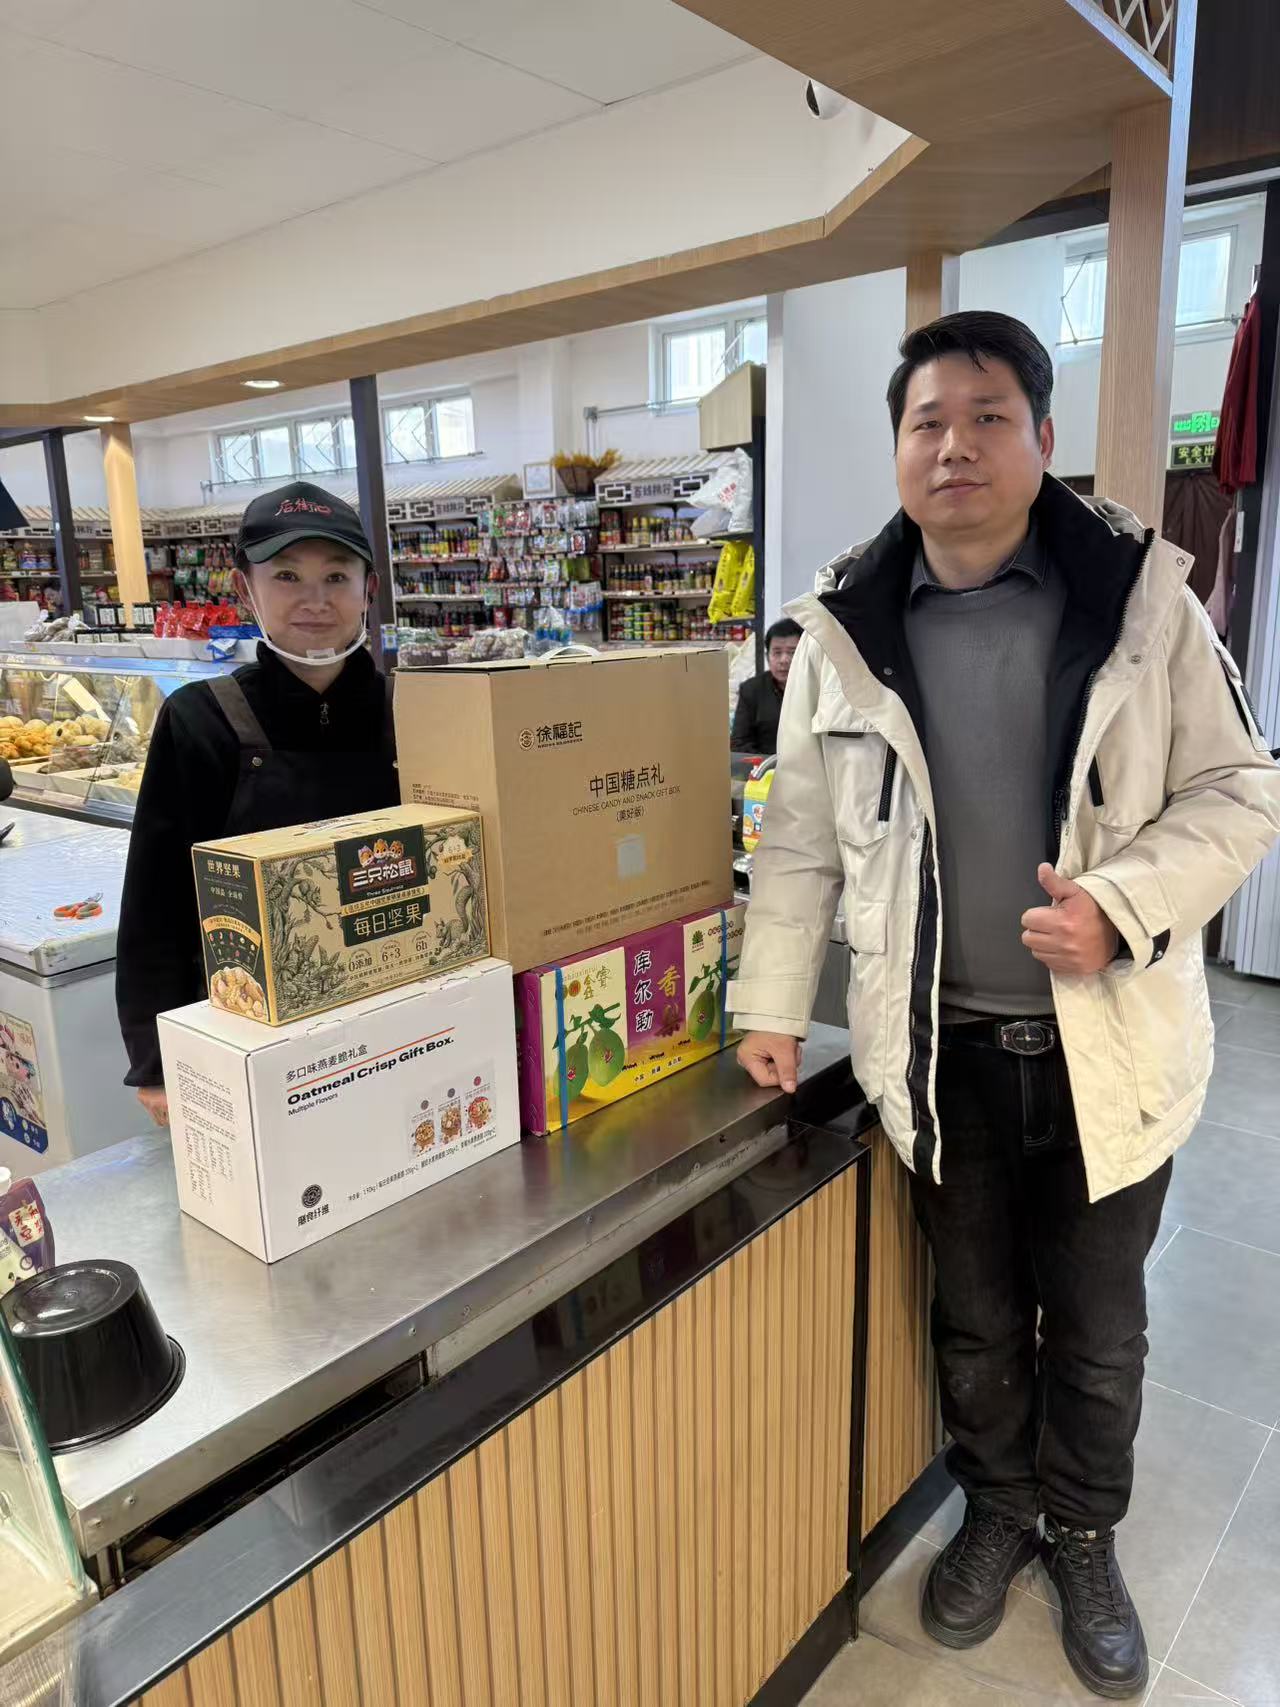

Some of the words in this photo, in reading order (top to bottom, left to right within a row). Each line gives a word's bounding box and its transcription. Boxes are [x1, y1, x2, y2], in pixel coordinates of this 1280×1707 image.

[536, 721, 583, 744] 徐福記
[589, 762, 665, 798] 中国糖点礼
[572, 802, 601, 816] CHINESE
[601, 797, 621, 810] CANDY
[622, 795, 635, 806] AND
[636, 791, 655, 803] SNACK
[656, 788, 668, 798] GIFT
[668, 785, 681, 796] BOX
[207, 859, 241, 879] 世界坚果
[352, 858, 414, 888] 三只松鼠
[352, 902, 422, 937] 每日坚果
[415, 940, 428, 952] 6h
[633, 949, 654, 1033] 库尔勒
[285, 1043, 368, 1083] 多口味燕麦脆礼盒
[287, 1072, 355, 1106] Oatmeal
[356, 1058, 397, 1080] Crisp
[398, 1045, 426, 1064] Gift
[425, 1036, 455, 1053] Box.
[287, 1101, 315, 1117] Multiple
[315, 1092, 339, 1106] Flavors
